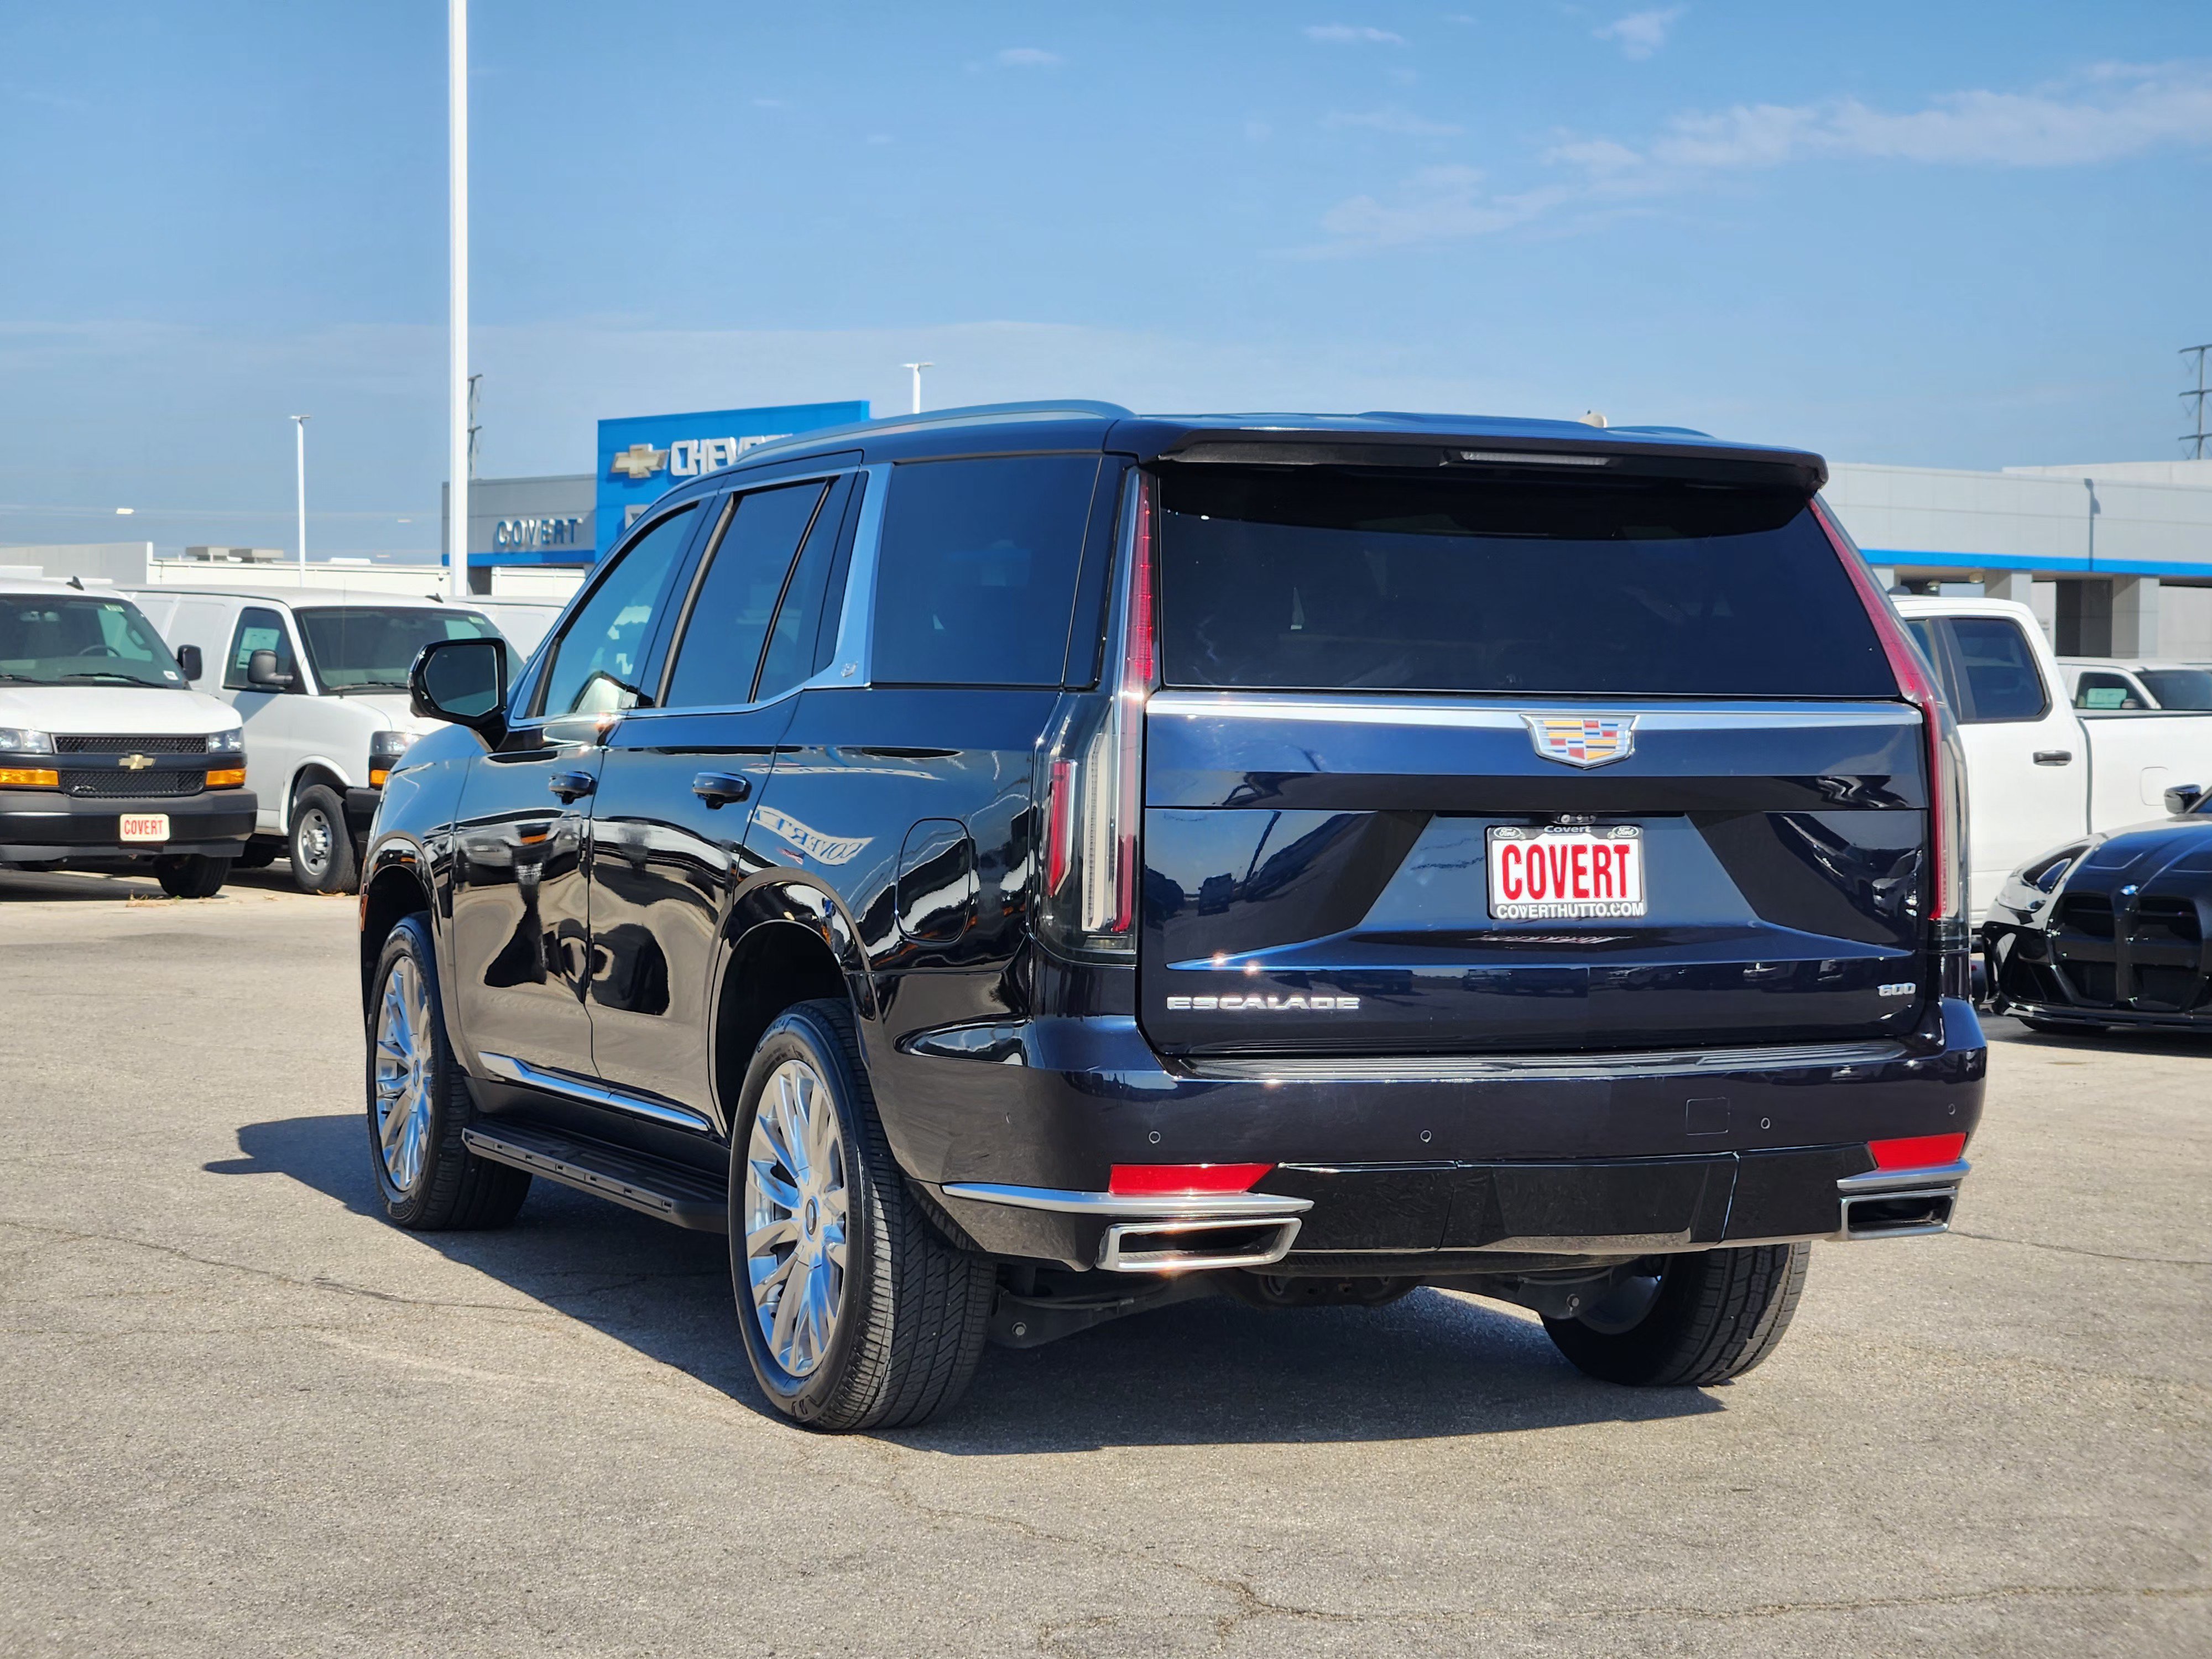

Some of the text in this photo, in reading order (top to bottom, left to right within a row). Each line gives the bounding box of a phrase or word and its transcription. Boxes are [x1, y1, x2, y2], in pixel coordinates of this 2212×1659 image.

[670, 433, 793, 476] CHEV
[497, 518, 583, 546] COVERT
[124, 820, 163, 835] COVERT
[1502, 844, 1630, 900] COVERT
[1496, 902, 1644, 919] COVERTHUTTO.COM
[1877, 983, 1916, 997] 600
[1167, 997, 1360, 1010] ESCALADE
